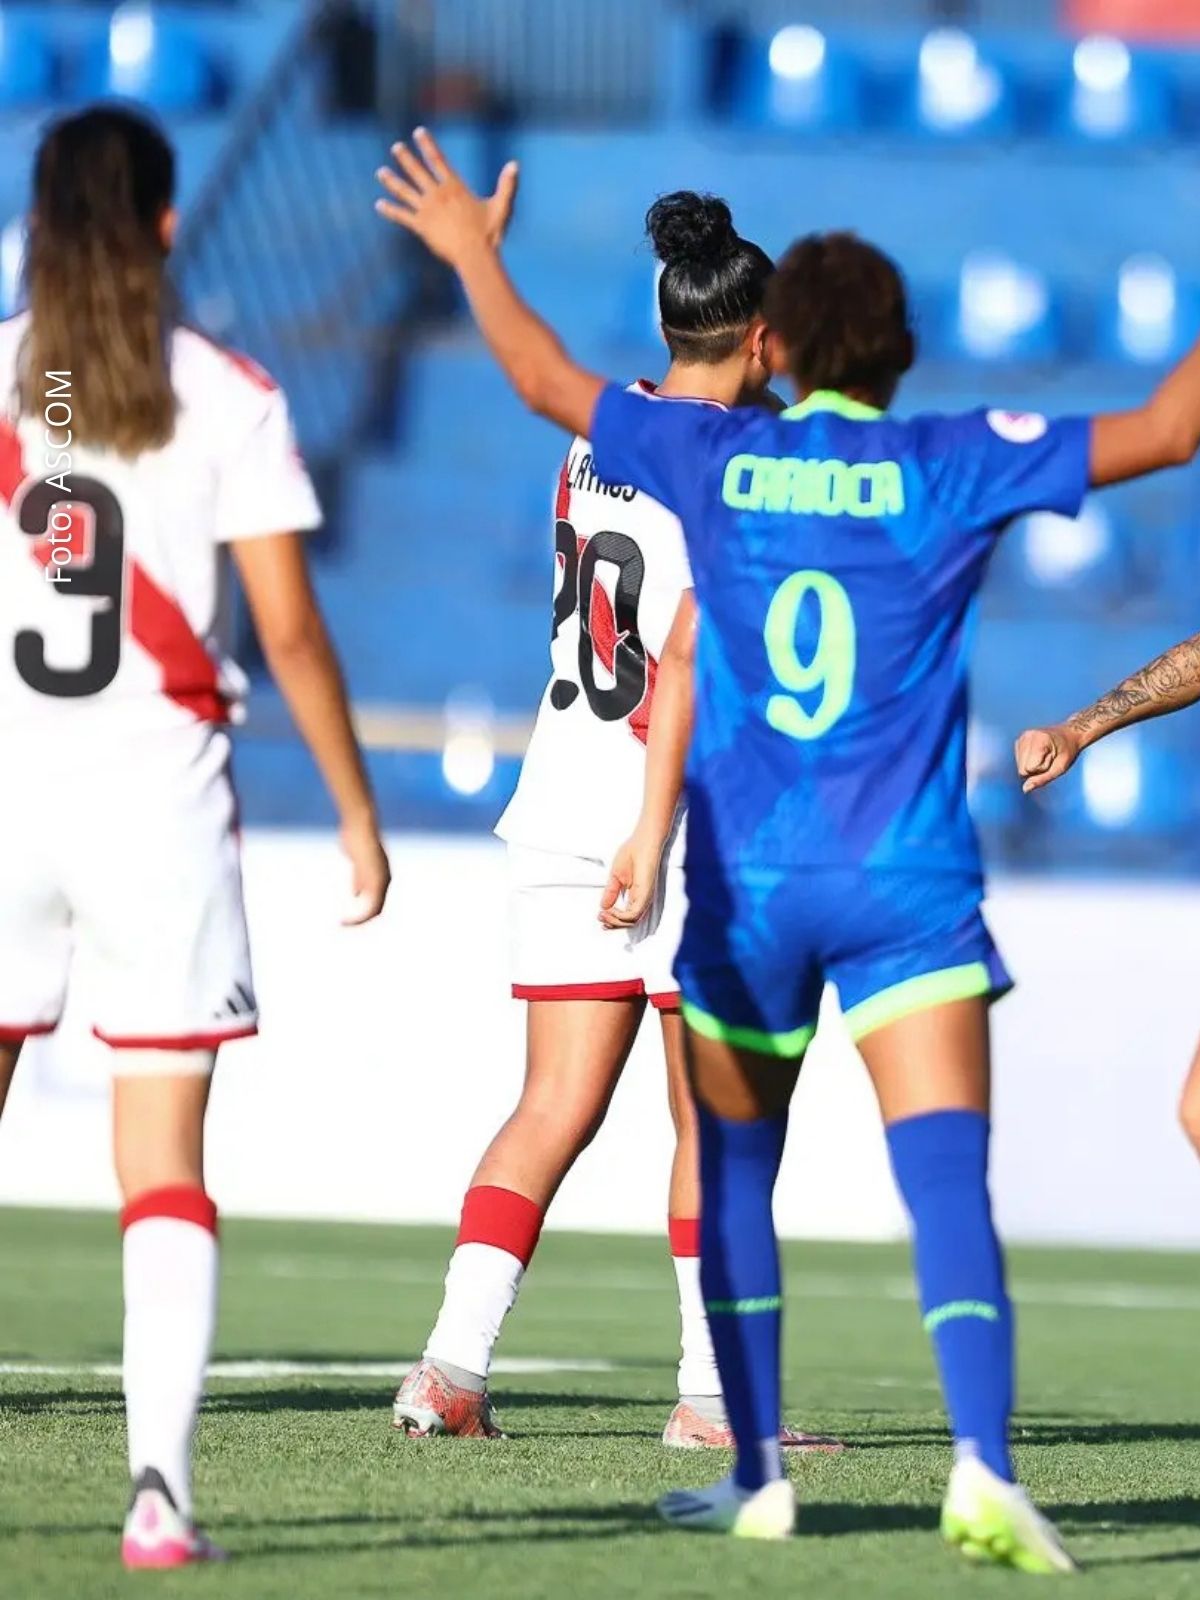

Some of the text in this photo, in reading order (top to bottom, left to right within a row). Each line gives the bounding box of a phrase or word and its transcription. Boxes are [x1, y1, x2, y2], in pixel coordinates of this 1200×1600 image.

[721, 453, 906, 518] CARIOCA
[14, 473, 124, 698] 3
[764, 568, 857, 741] 9
